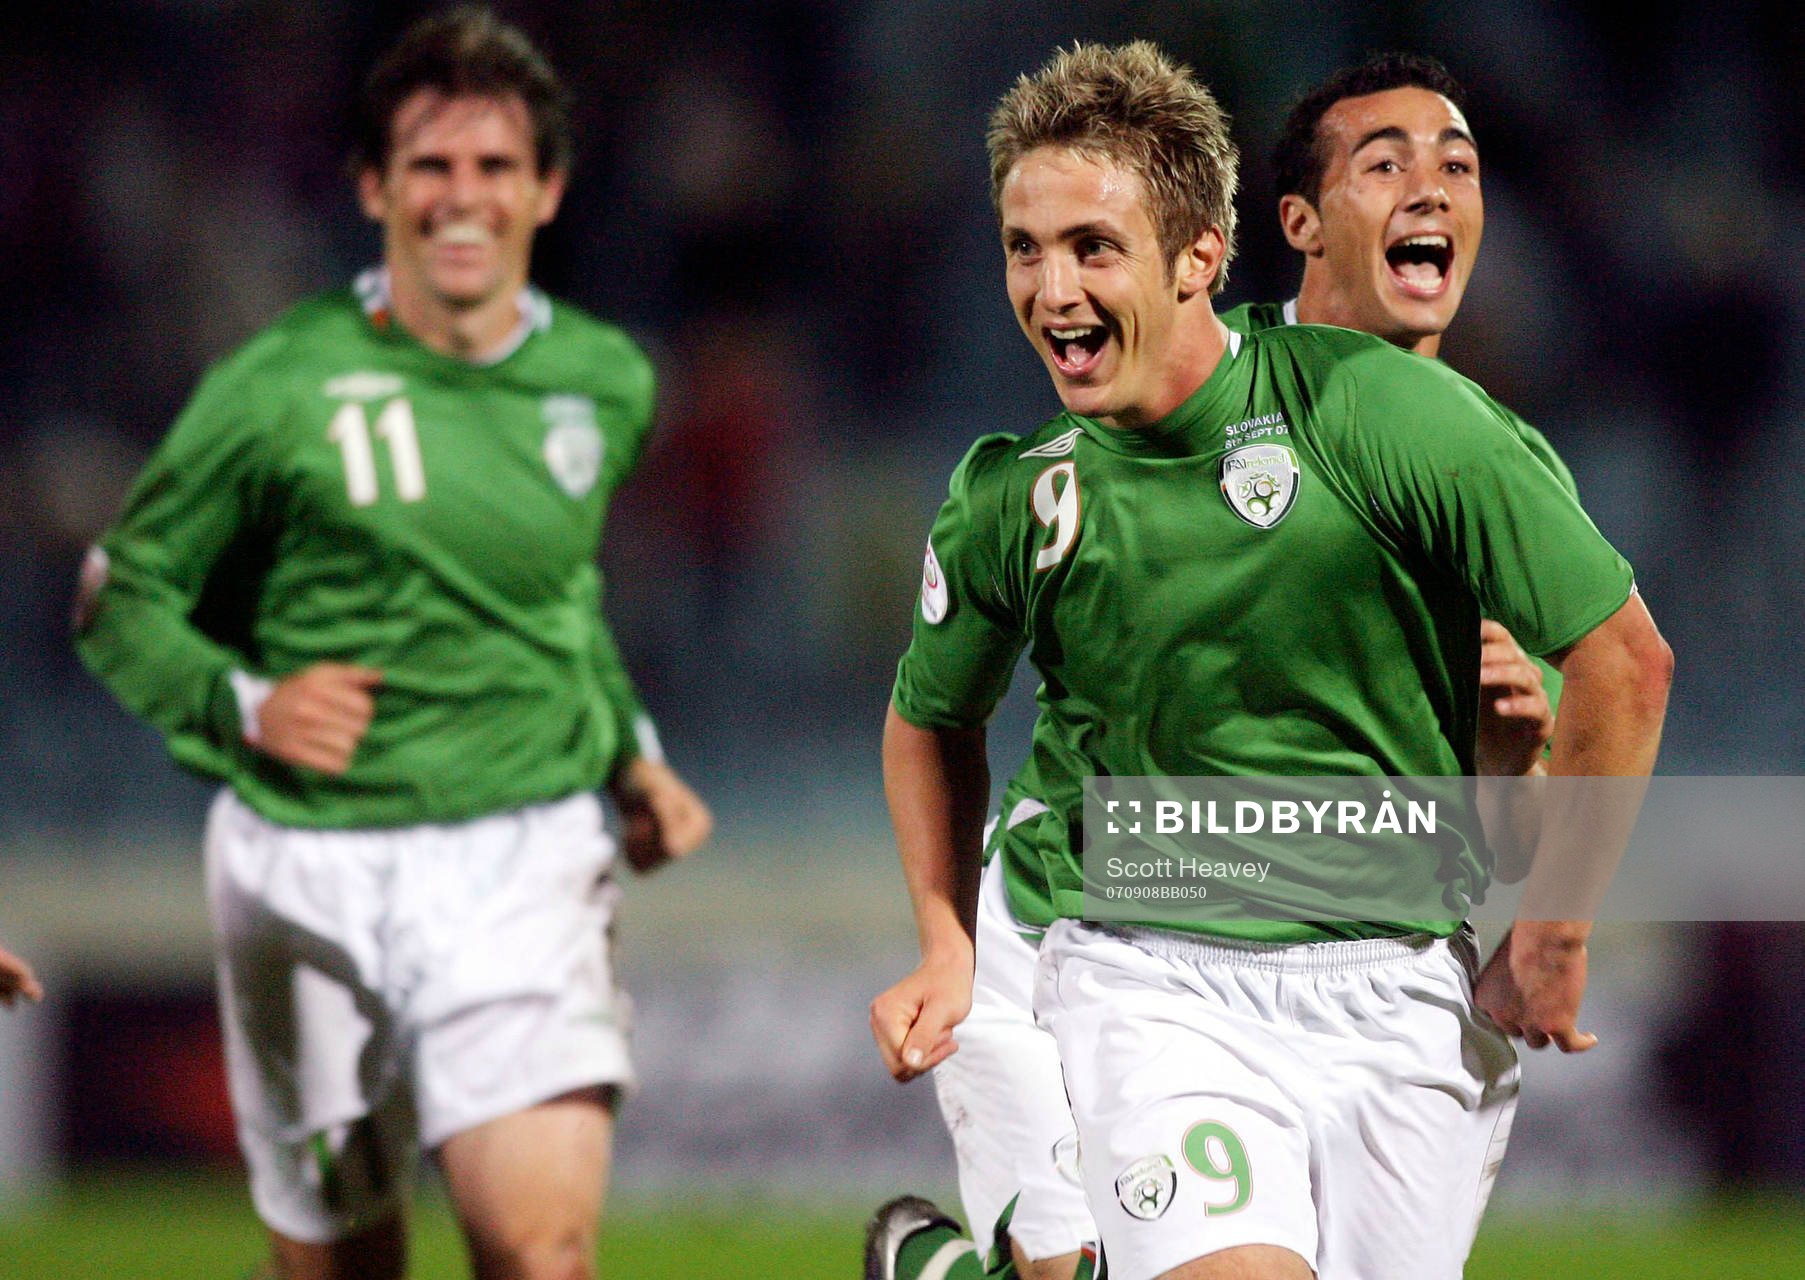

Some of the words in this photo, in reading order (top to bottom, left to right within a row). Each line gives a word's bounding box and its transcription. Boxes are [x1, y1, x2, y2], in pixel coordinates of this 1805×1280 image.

[327, 399, 426, 507] 11
[1225, 411, 1284, 436] SLOVAKIA
[1245, 427, 1273, 441] SEPT
[1030, 460, 1082, 573] 9
[1182, 1118, 1254, 1217] 9
